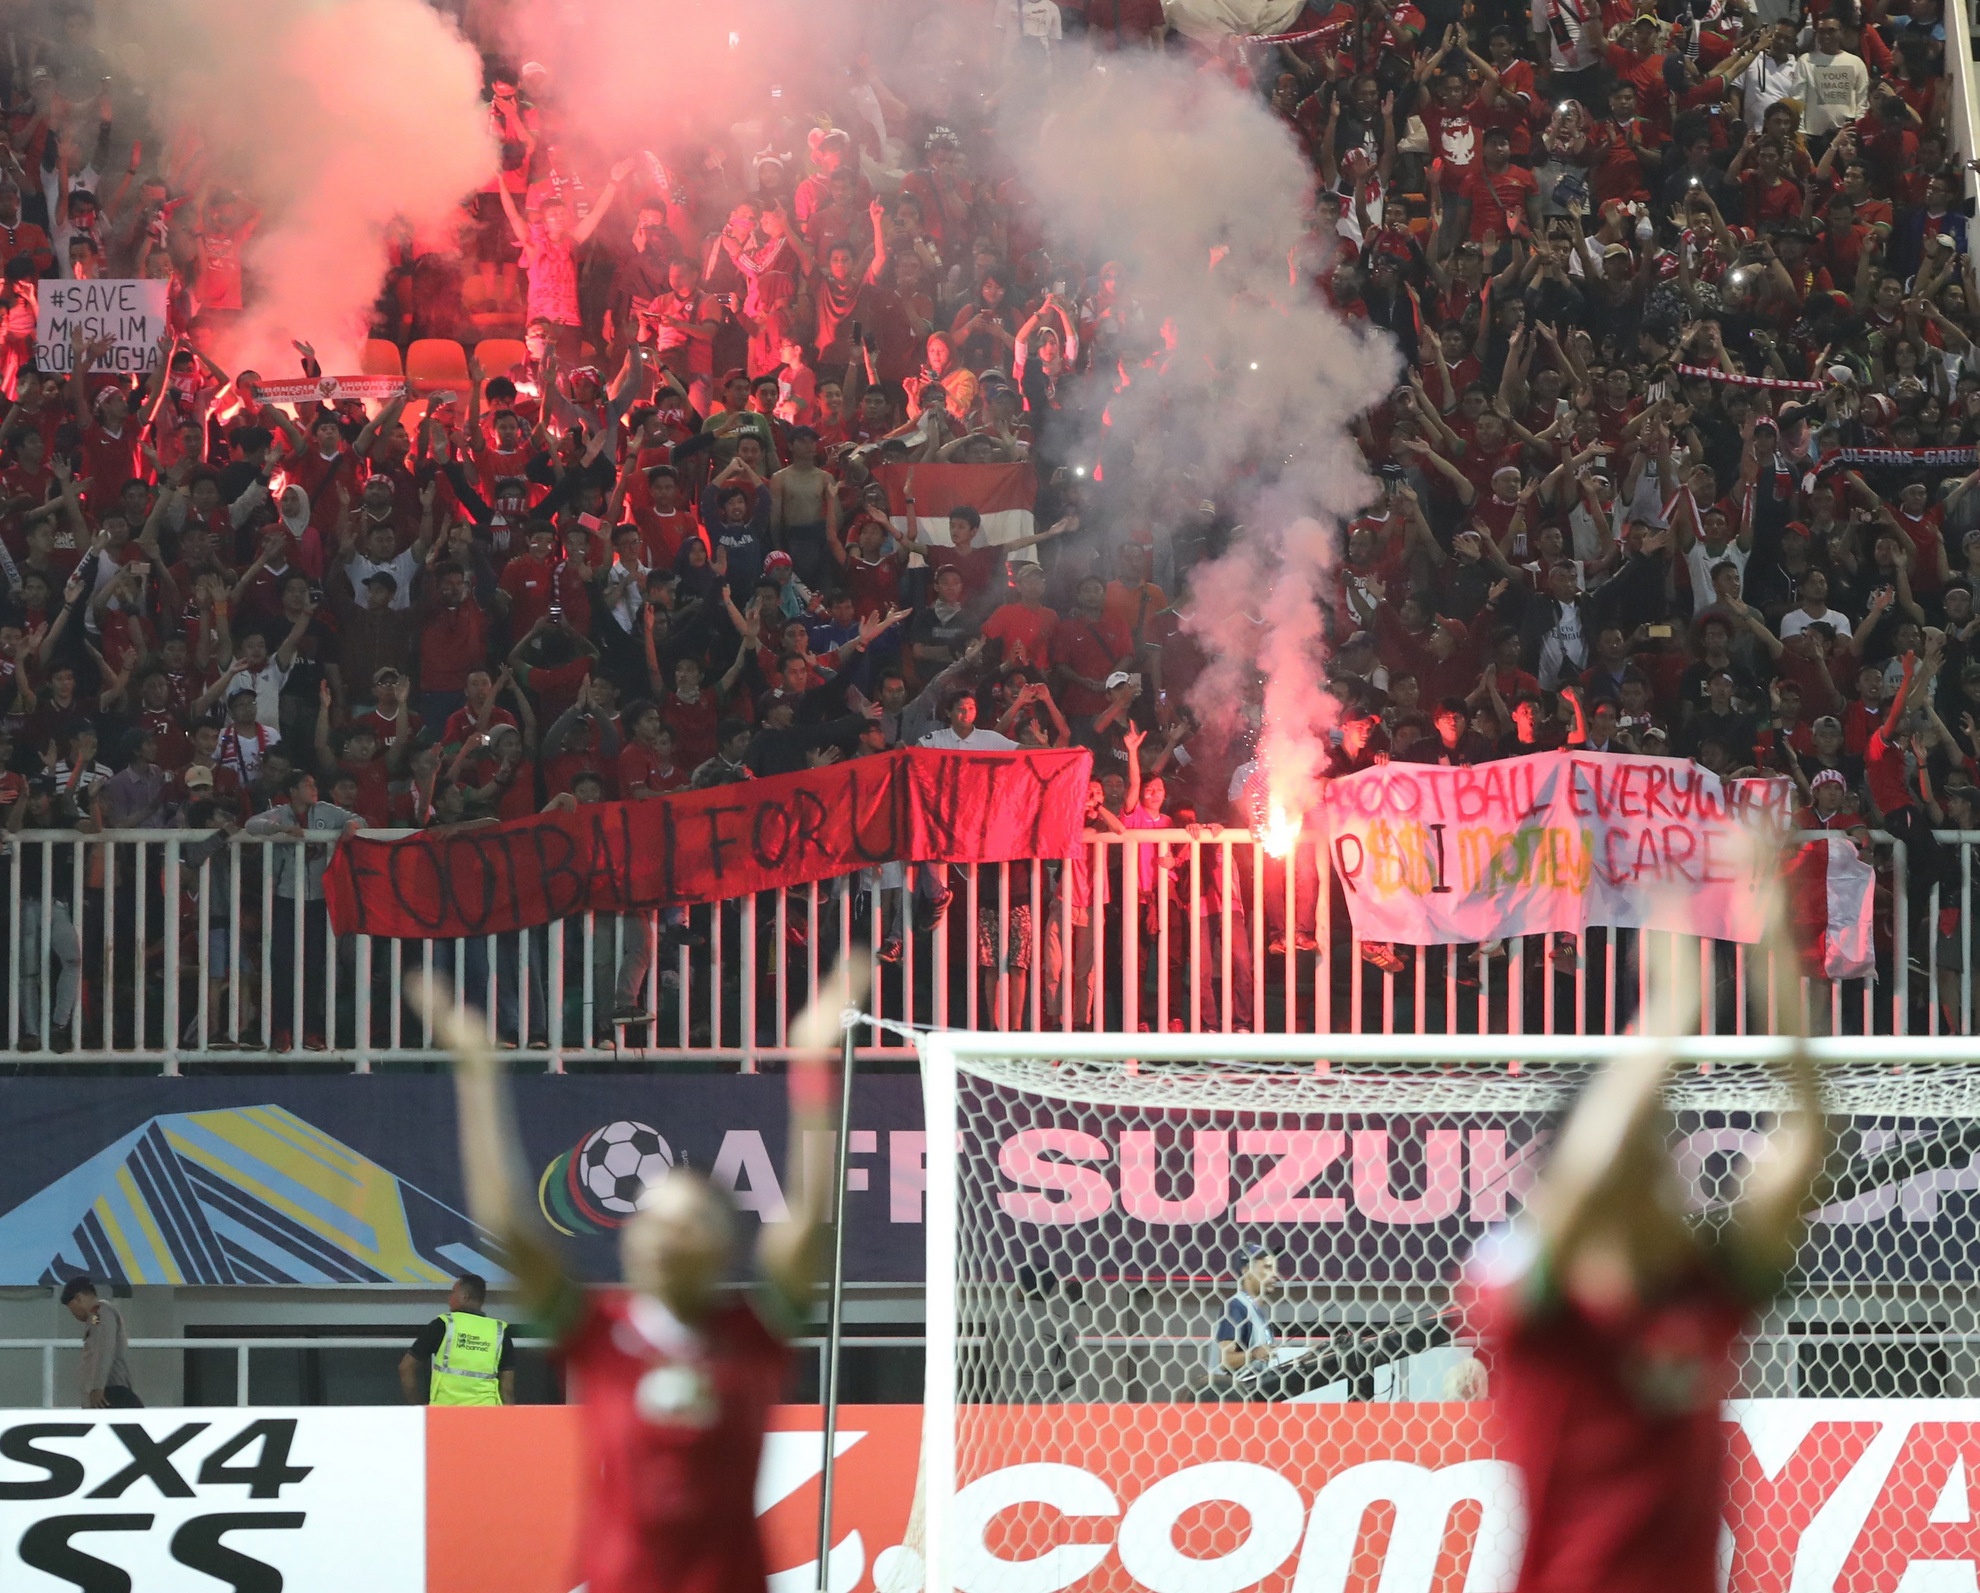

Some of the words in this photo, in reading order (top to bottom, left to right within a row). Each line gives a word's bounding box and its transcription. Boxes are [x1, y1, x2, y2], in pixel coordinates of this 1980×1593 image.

[1823, 72, 1849, 80] YOUR
[1824, 91, 1847, 99] HERE
[50, 285, 136, 313] #SAVE
[37, 343, 158, 371] ROHNGYA
[341, 380, 405, 391] INDONESIA
[1686, 366, 1817, 388] INDONESIA
[343, 801, 706, 932] FOOTBALL
[704, 787, 832, 879] FOR
[849, 754, 1079, 862] UNITY
[706, 1129, 964, 1224] AFF
[0, 1418, 315, 1500] SX4
